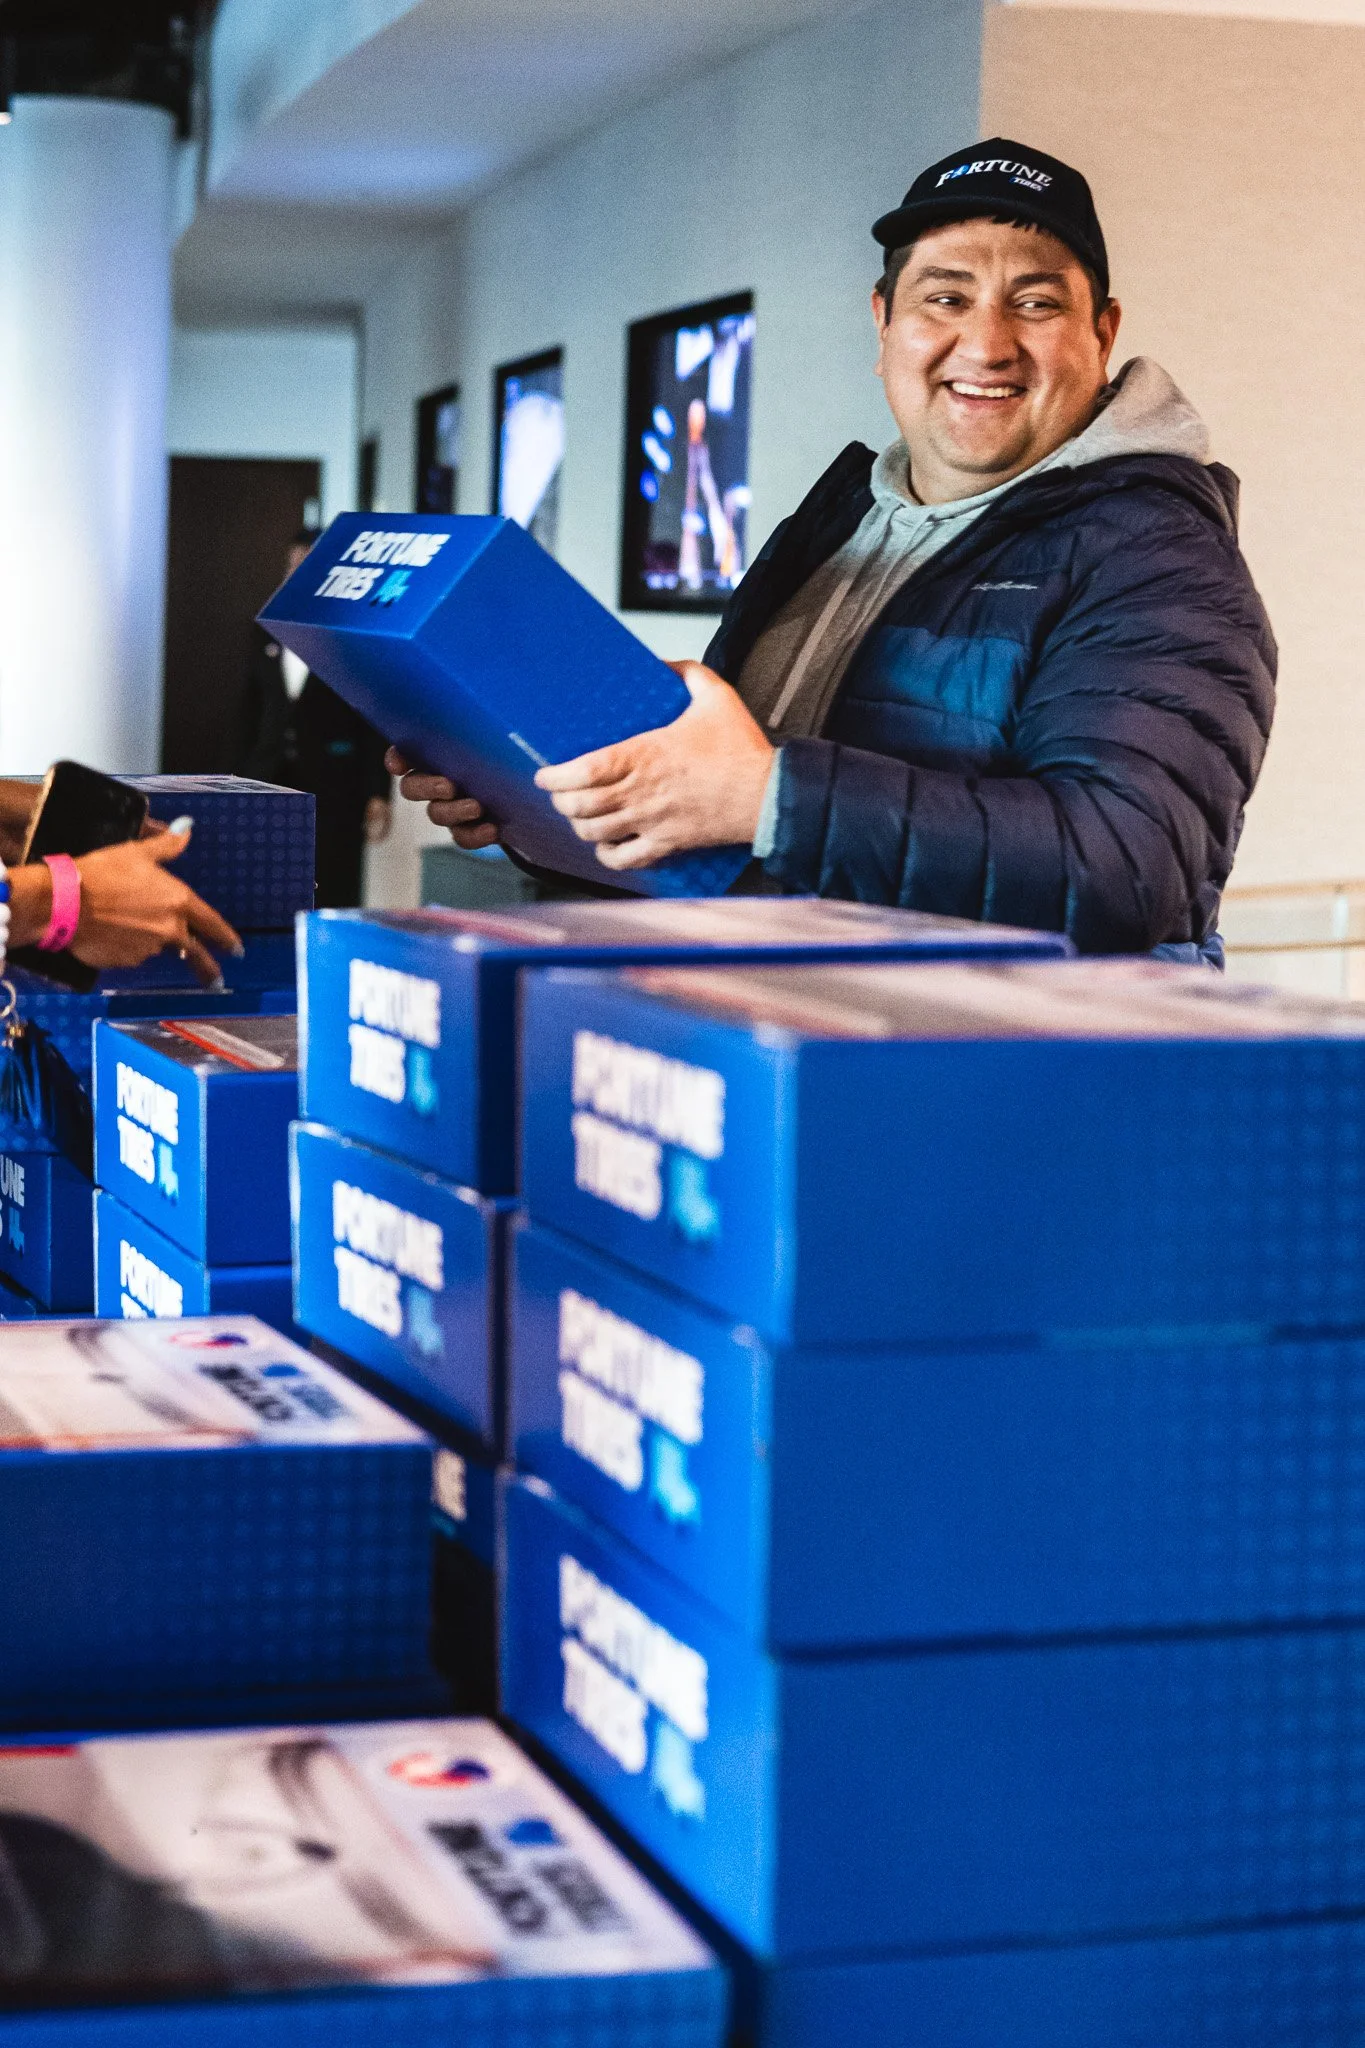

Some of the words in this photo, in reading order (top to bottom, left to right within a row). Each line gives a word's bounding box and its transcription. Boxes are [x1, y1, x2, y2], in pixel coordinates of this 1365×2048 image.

[314, 566, 385, 601] TIRES
[339, 531, 451, 568] FORTUNE
[348, 958, 442, 1050] FORTUNE
[117, 1061, 179, 1146] FORTUNE
[348, 1022, 406, 1105] TIRES
[571, 1029, 727, 1161] FORTUNE
[117, 1114, 156, 1185] TIRES
[570, 1110, 664, 1222] TIRES
[332, 1179, 444, 1292] FORTUNE
[333, 1246, 403, 1338] TIRES
[558, 1287, 706, 1446] FORTUNE
[557, 1368, 645, 1492] TIRES
[558, 1552, 709, 1742] FORTUNE
[559, 1636, 649, 1775] TIRES
